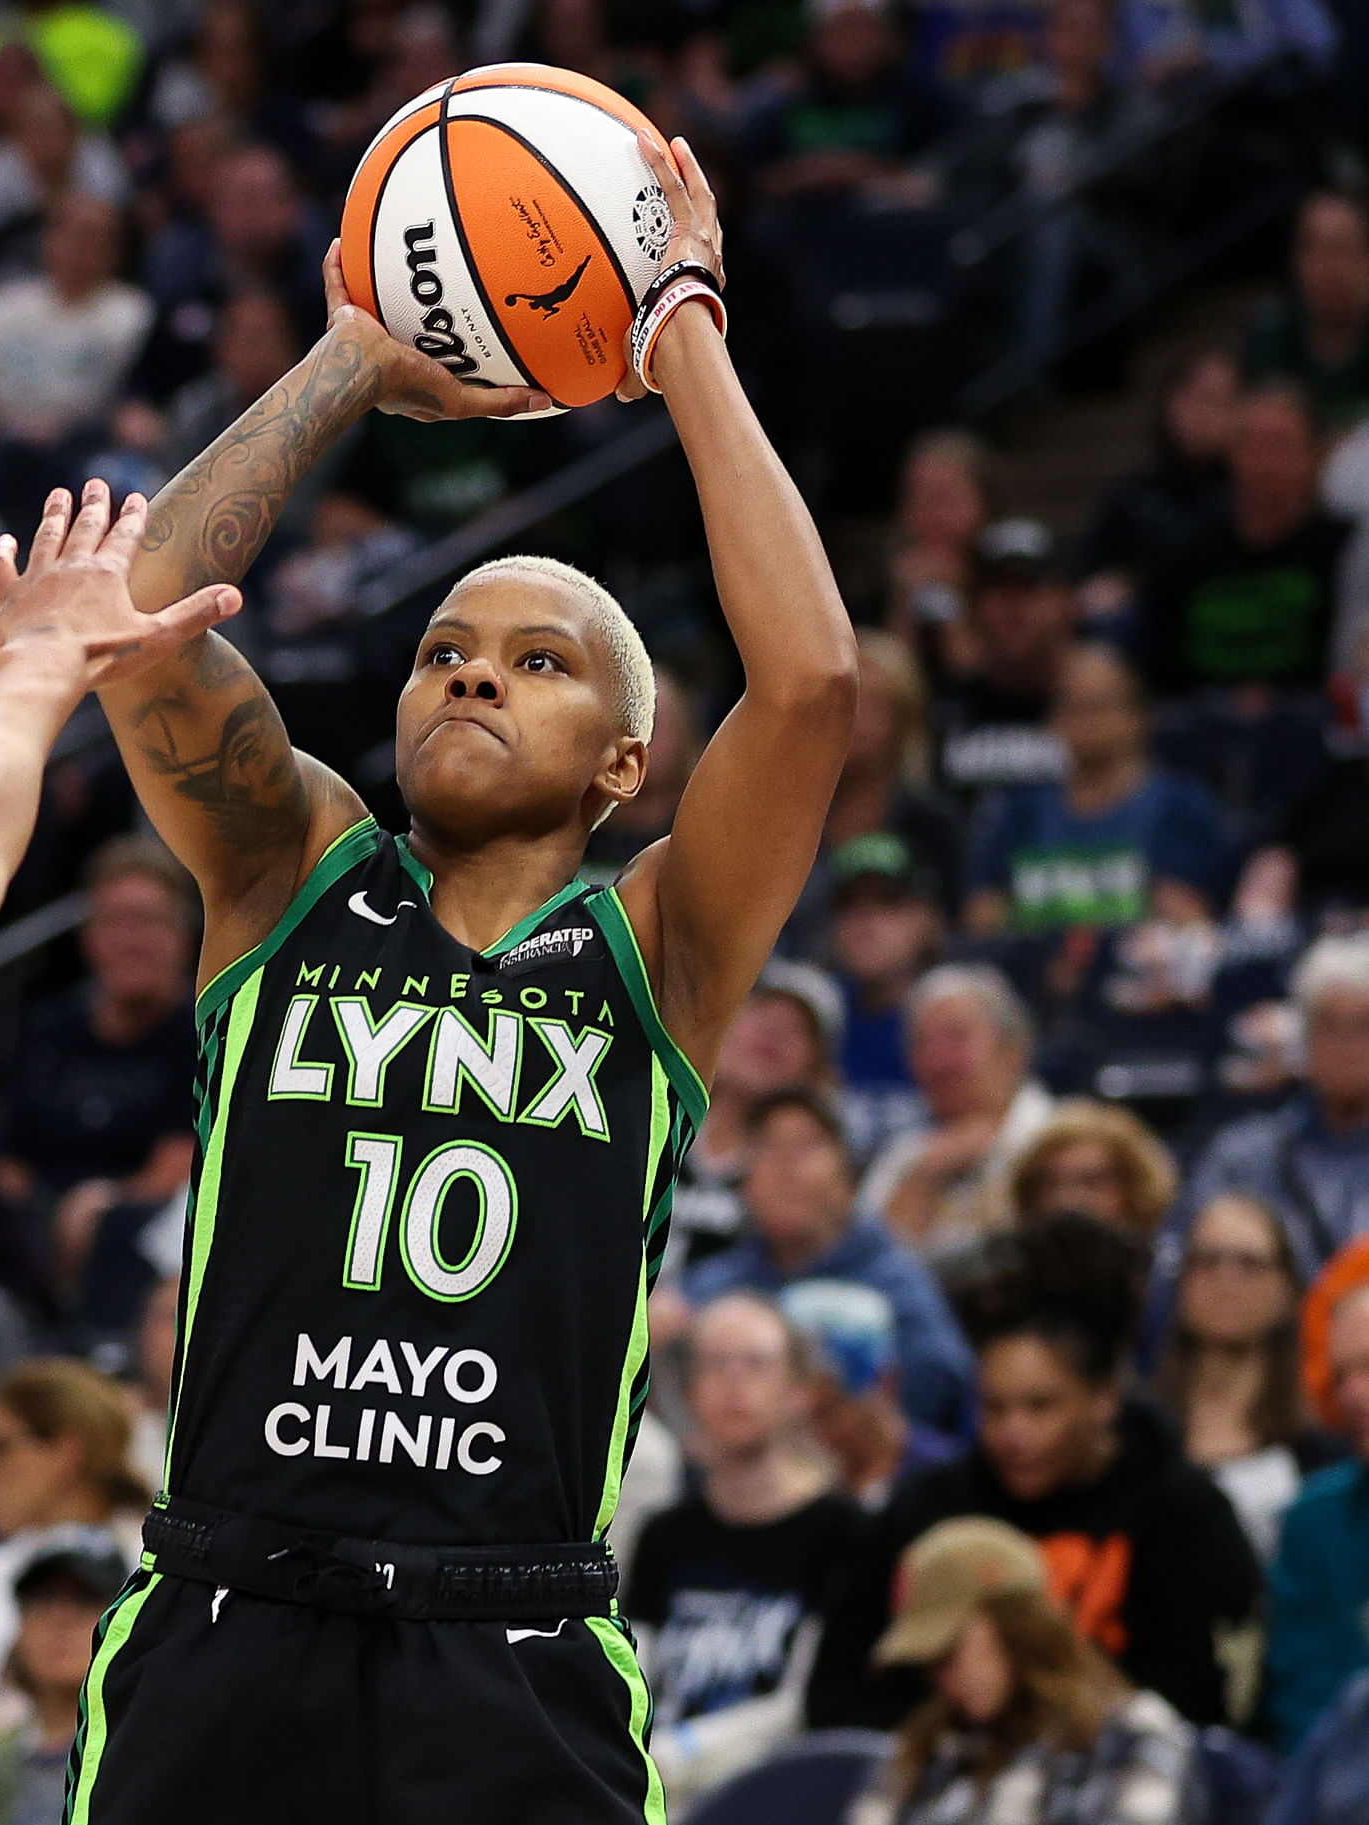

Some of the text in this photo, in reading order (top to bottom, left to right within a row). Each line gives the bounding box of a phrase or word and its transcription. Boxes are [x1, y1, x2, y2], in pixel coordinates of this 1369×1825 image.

[651, 263, 681, 289] VERY
[653, 302, 666, 318] DO
[666, 292, 678, 304] IT
[461, 307, 492, 359] EVO NXT
[580, 312, 597, 340] BALL
[295, 960, 615, 1027] MINNESOTA
[267, 994, 615, 1143] LYNX
[342, 1130, 519, 1304] 10
[292, 1332, 498, 1404] MAYO
[264, 1401, 507, 1475] CLINIC
